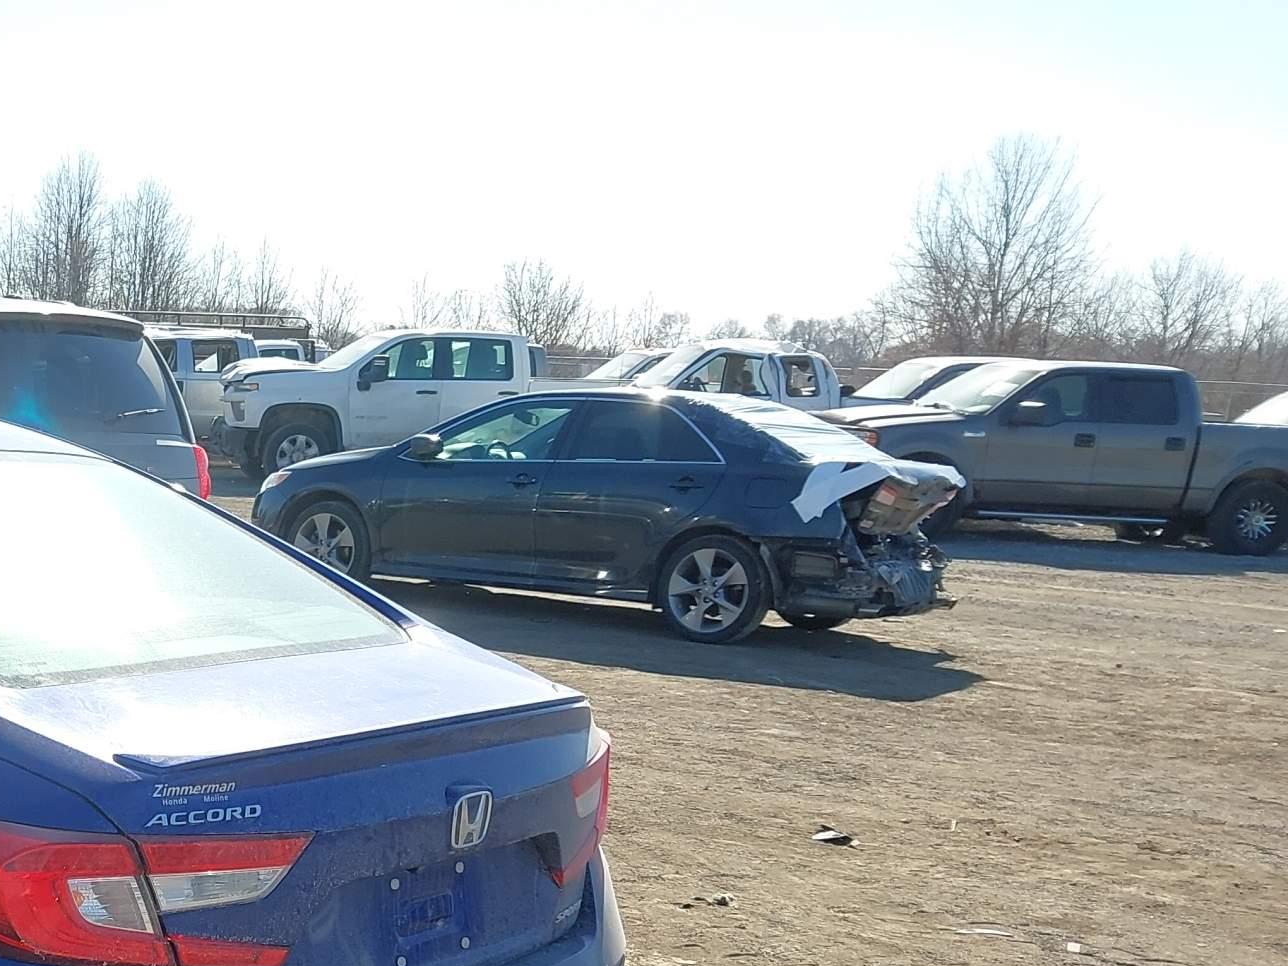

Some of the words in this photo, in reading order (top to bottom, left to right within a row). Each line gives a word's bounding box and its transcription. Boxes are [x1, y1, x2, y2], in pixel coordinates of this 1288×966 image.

[152, 782, 236, 798] Zimmerman
[162, 798, 188, 806] Honda
[203, 794, 229, 803] Moline
[144, 804, 262, 828] ACCORD
